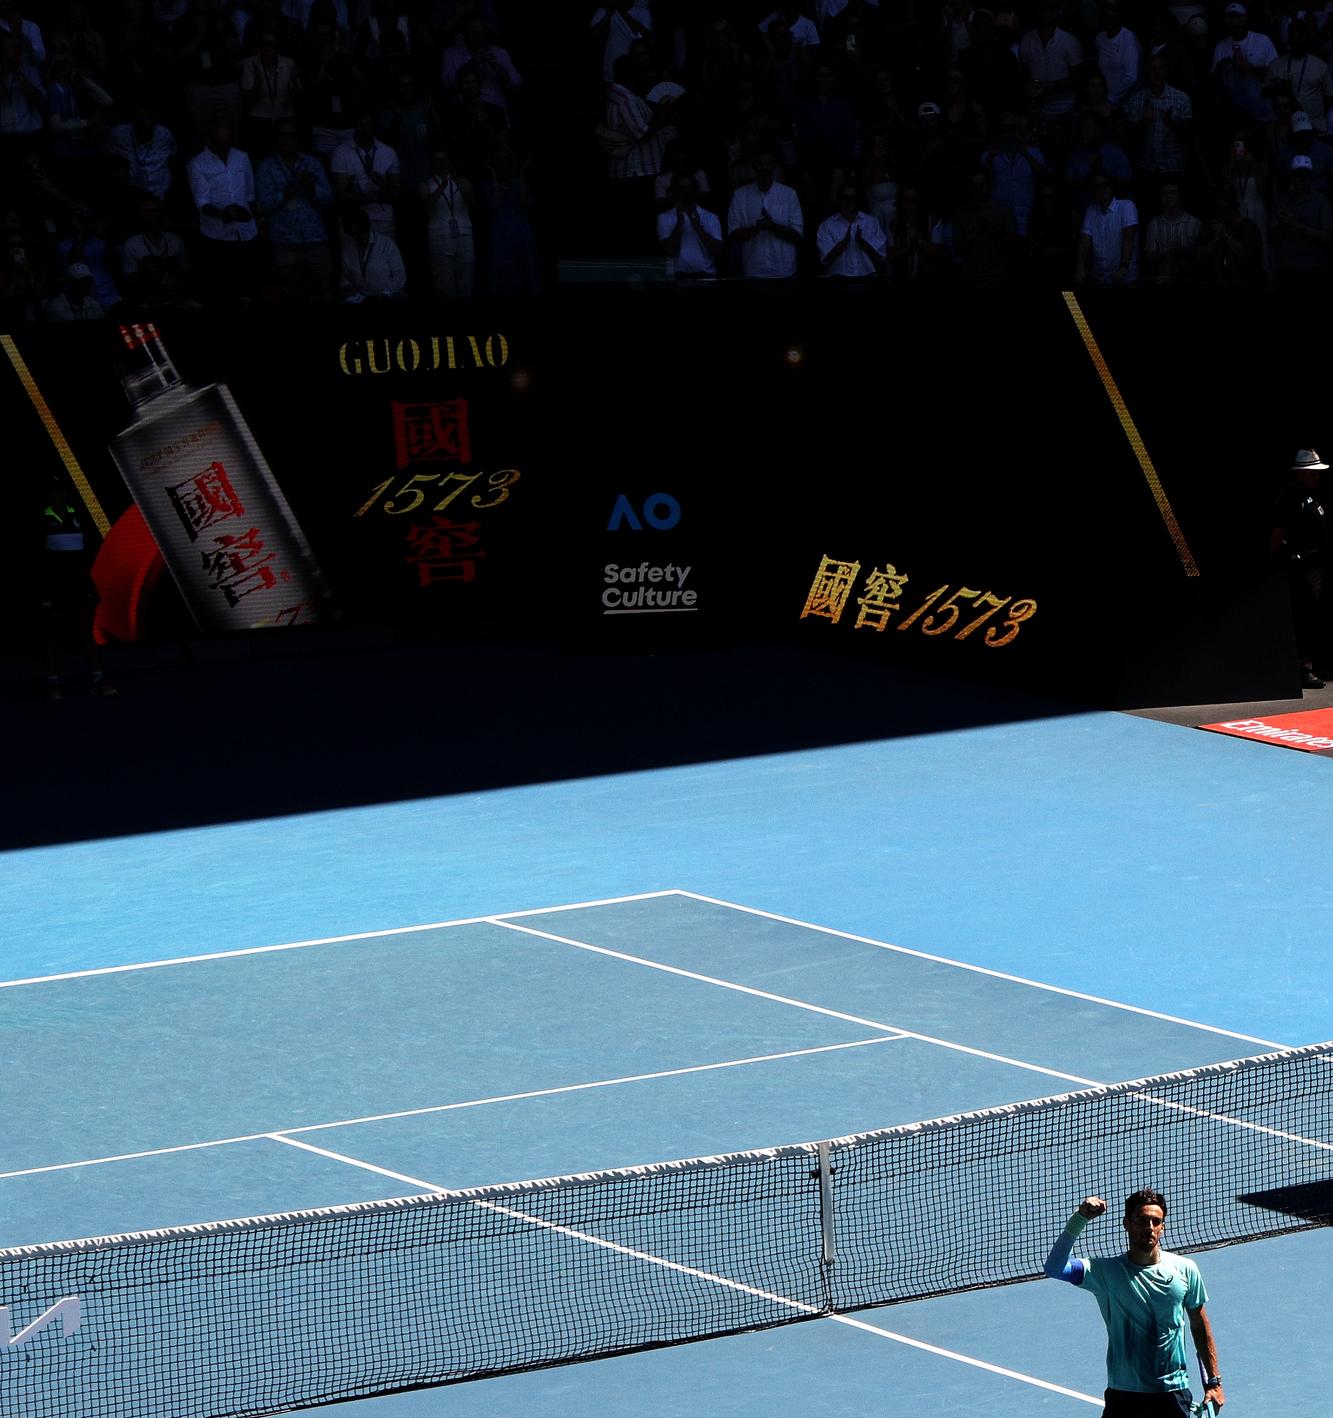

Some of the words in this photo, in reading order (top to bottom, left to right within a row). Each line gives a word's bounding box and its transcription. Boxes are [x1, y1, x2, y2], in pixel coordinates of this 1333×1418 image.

[339, 334, 510, 375] GUOJIAO
[353, 470, 520, 517] 1573
[607, 492, 682, 531] AO
[603, 562, 692, 589] Safety
[602, 586, 698, 608] Culture
[897, 584, 1037, 648] 1573
